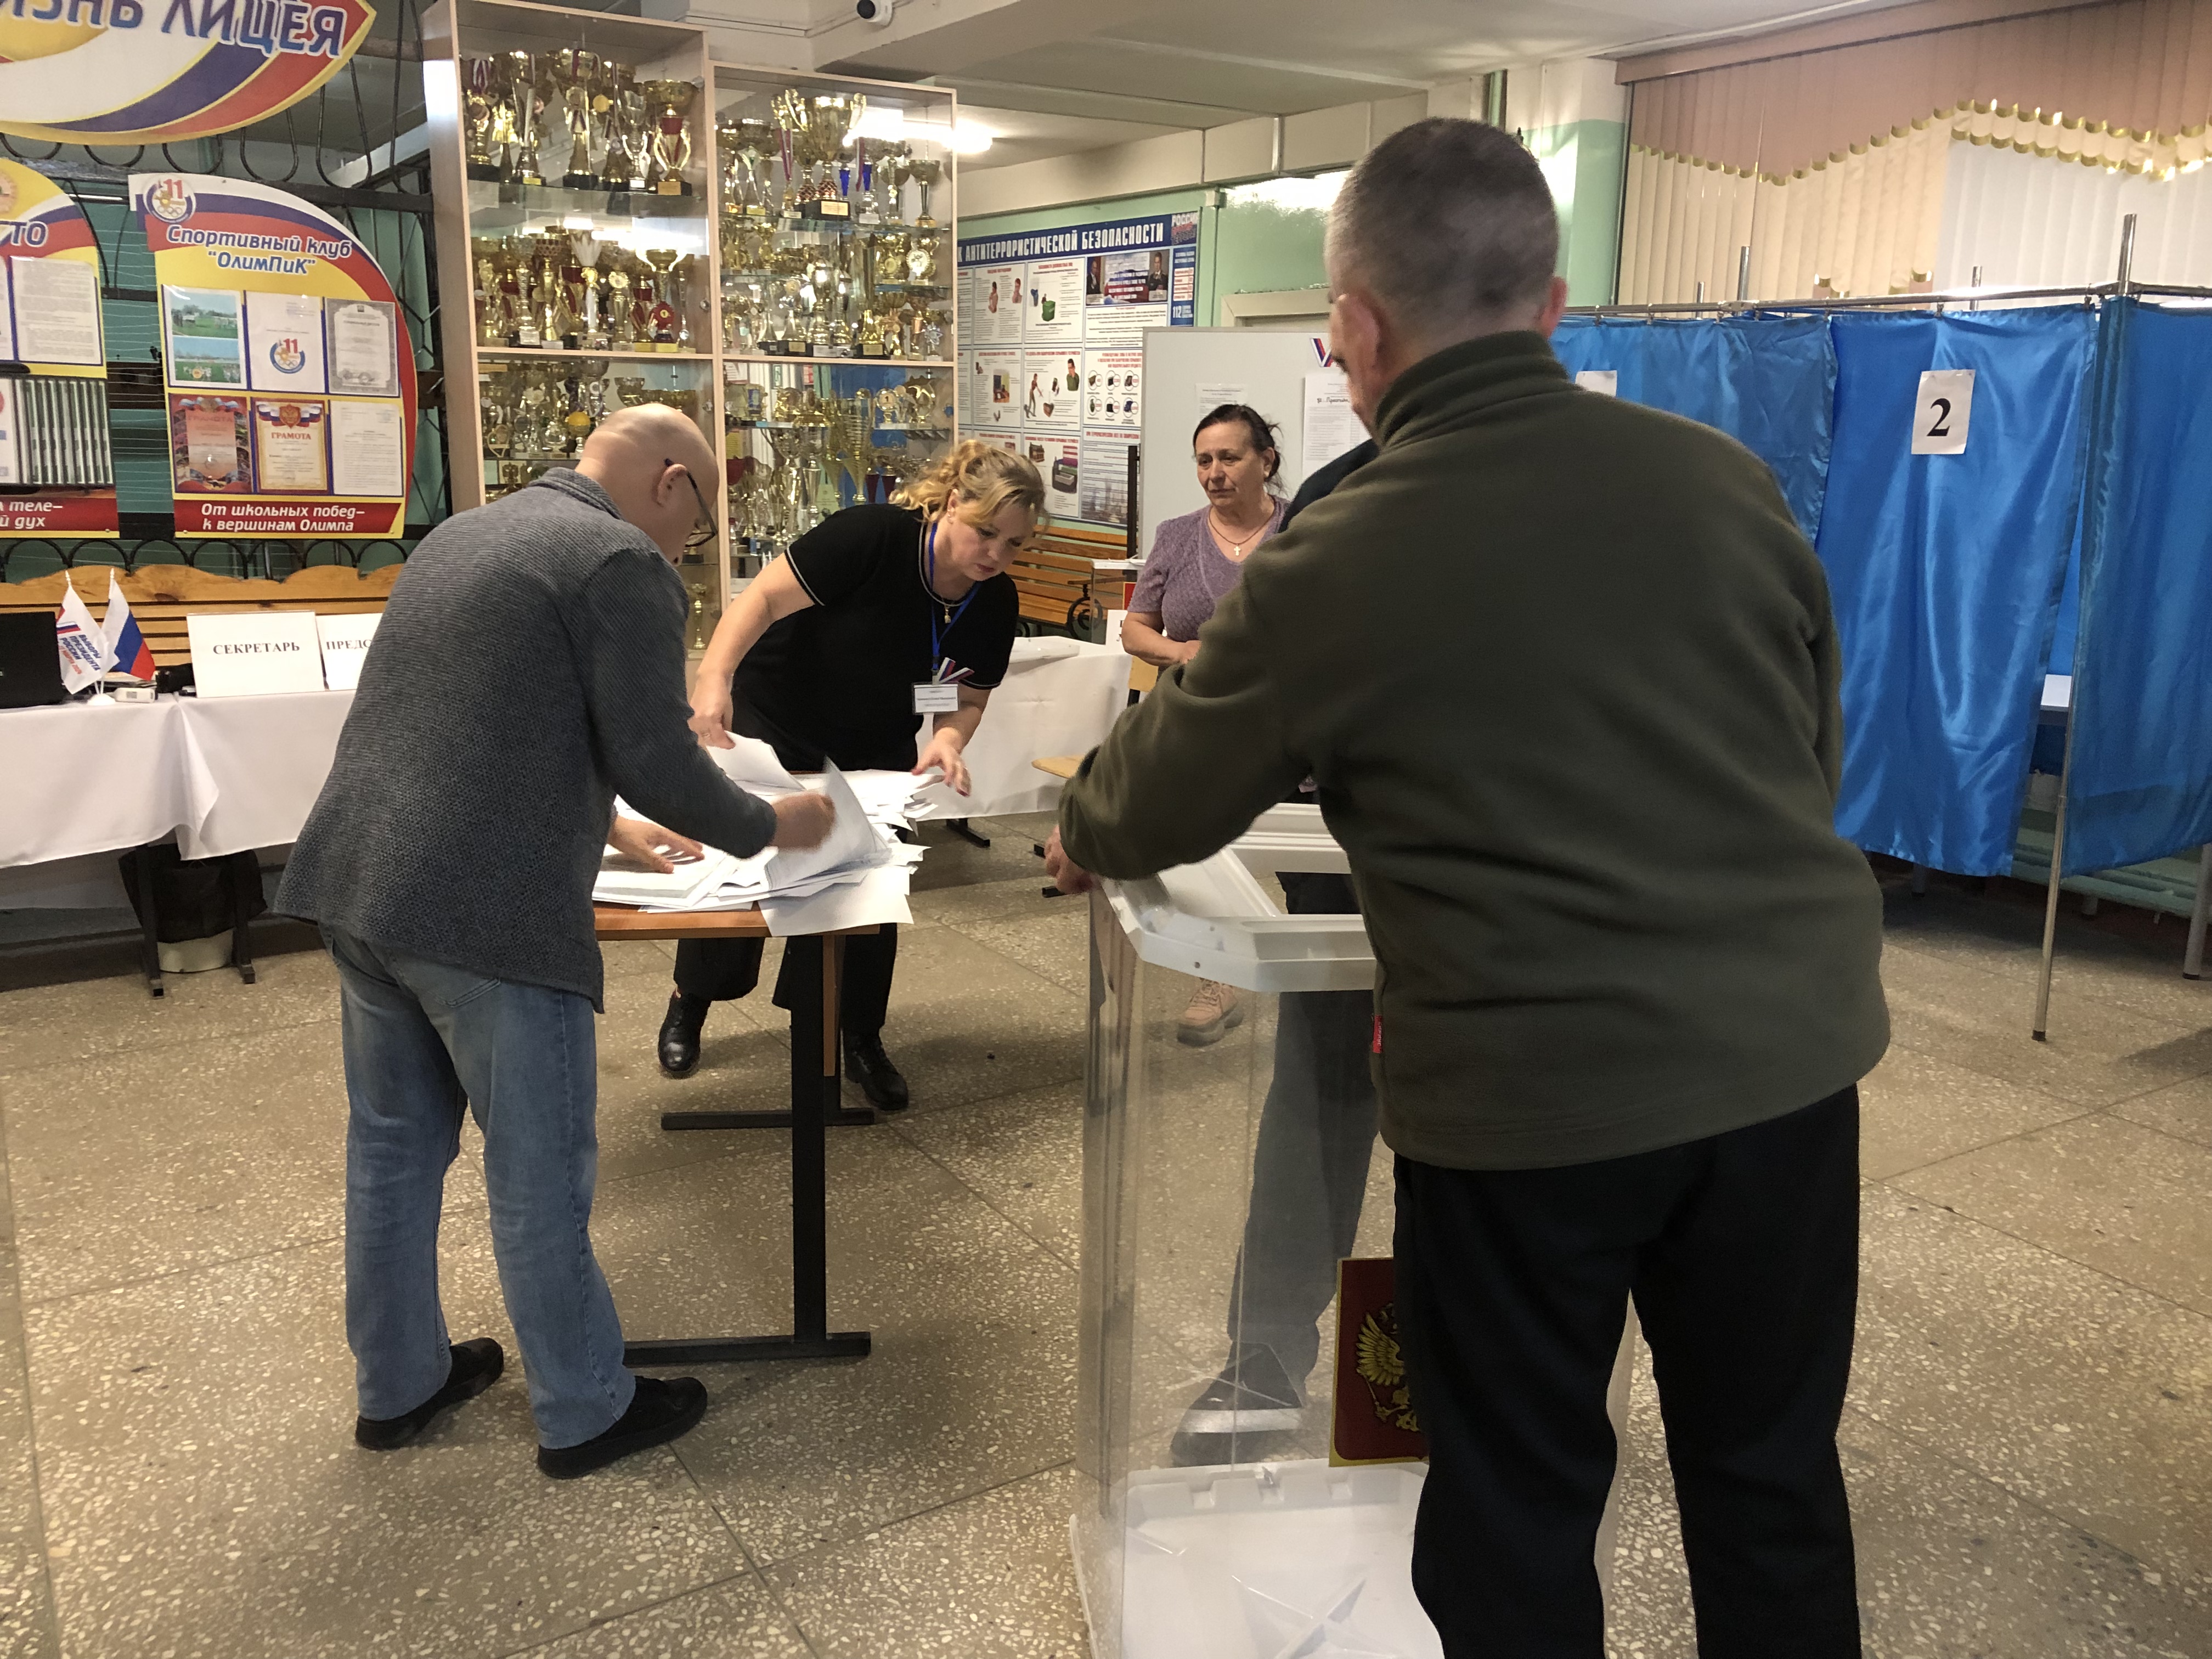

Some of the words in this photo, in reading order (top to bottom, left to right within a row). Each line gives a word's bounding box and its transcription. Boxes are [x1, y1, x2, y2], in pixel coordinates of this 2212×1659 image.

[162, 0, 345, 55] ЛИЦЕЯ
[163, 179, 183, 199] 11
[0, 221, 46, 245] ТО
[168, 226, 300, 252] Спортивный
[307, 238, 352, 257] клуб
[966, 230, 1077, 261] АНТИТЕРРОРИСТИЧЕСКОЙ
[1081, 223, 1164, 250] БЕЗОПАСНОСТИ
[284, 338, 298, 353] 11
[1926, 398, 1951, 436] 2
[271, 432, 311, 440] ГРАМОТА
[201, 504, 227, 515] От
[231, 504, 308, 517] школьных
[14, 517, 46, 529] дух
[217, 521, 296, 532] вершинам
[300, 520, 354, 531] Олимпа
[60, 637, 82, 659] РОССИИ
[69, 636, 101, 670] ПРЕЗИДЕНТА
[78, 634, 101, 659] ВЫБОРЫ
[213, 642, 300, 654] СЕКРЕТАРЬ
